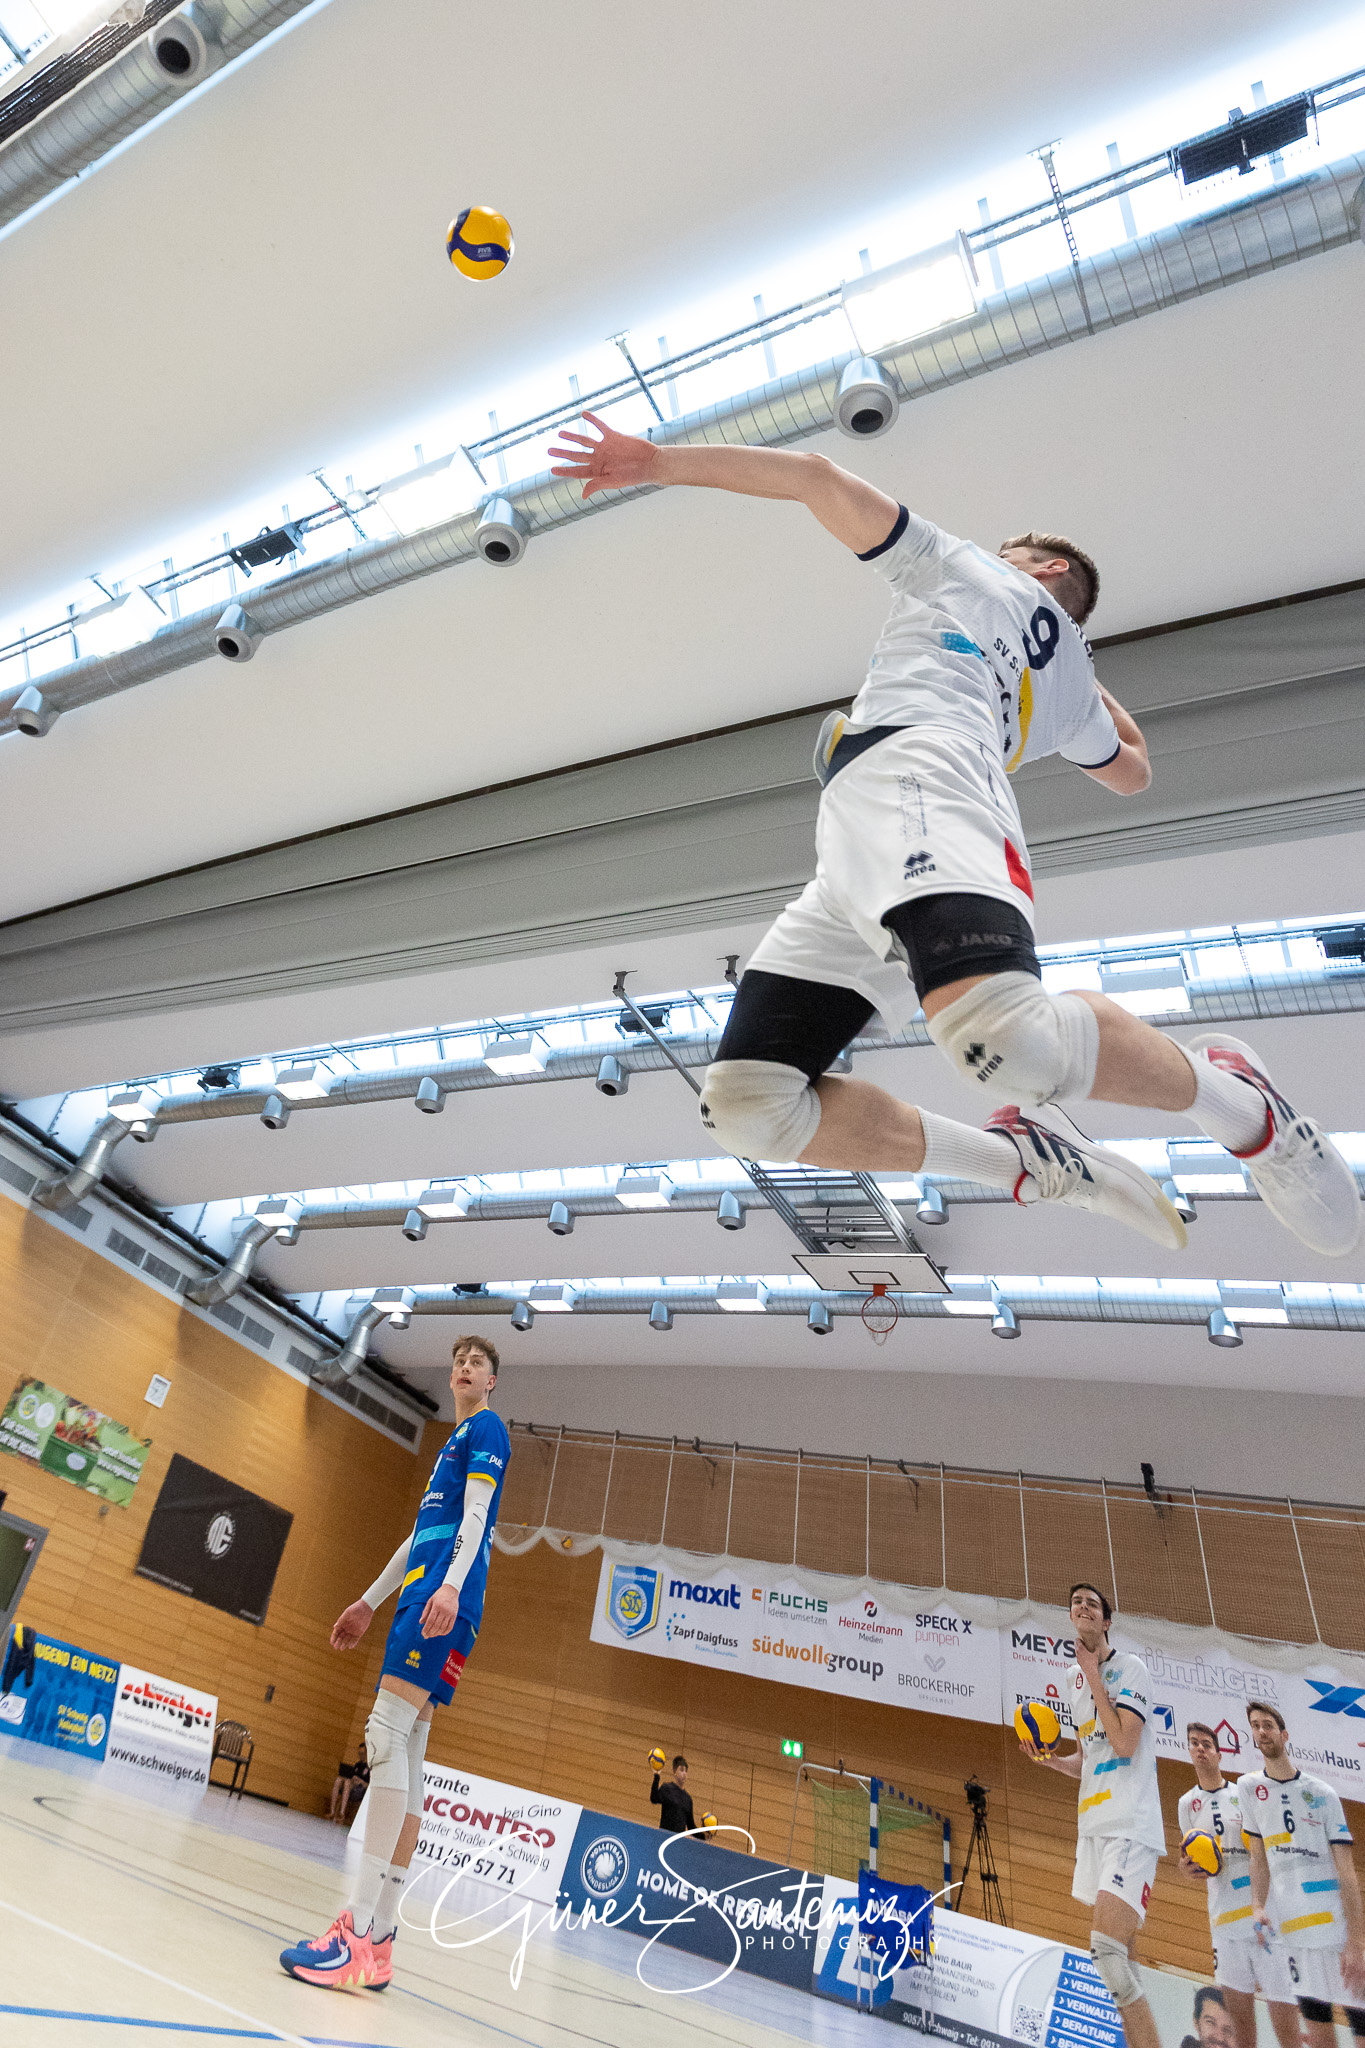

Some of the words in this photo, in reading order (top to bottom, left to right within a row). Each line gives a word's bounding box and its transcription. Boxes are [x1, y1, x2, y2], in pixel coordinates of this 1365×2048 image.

[993, 637, 1011, 658] SV
[1022, 605, 1060, 670] 9
[960, 933, 1013, 947] JAKO
[669, 1580, 741, 1610] maxit
[769, 1591, 829, 1614] FUCHS
[790, 1612, 828, 1626] umsetzen
[838, 1615, 904, 1637] Heinzelmann
[915, 1613, 959, 1632] SPECK
[673, 1625, 696, 1640] Zapf
[697, 1631, 739, 1648] Daigfuss
[858, 1632, 884, 1645] Medien
[915, 1630, 960, 1647] pumpen
[1012, 1651, 1037, 1663] Druck
[70, 1655, 89, 1674] EIN
[88, 1661, 118, 1684] NETZ!
[897, 1673, 976, 1698] BROCKERHOF
[120, 1681, 212, 1729] schweiger
[110, 1745, 207, 1785] www.schweiger.de
[503, 1805, 524, 1819] bei
[527, 1804, 562, 1818] Gino
[1283, 1809, 1296, 1834] 6
[1212, 1813, 1225, 1836] 5
[421, 1818, 451, 1837] dorfer
[454, 1828, 486, 1848] Straße
[506, 1844, 550, 1872] Schwaig
[590, 1842, 624, 1867] VOLLEYBALL
[1275, 1845, 1291, 1854] Zapf
[473, 1858, 495, 1877] 57
[496, 1864, 516, 1885] 71
[586, 1867, 620, 1891] BUNDESLIGA
[636, 1867, 690, 1902] HOME
[693, 1886, 720, 1910] OF
[722, 1893, 806, 1938] RESPECT
[950, 1959, 973, 1972] BAUR
[961, 1985, 980, 1998] UND
[1071, 1979, 1112, 2001] VERMIET
[902, 2011, 925, 2028] 9057
[1061, 2017, 1117, 2044] BERATUNG
